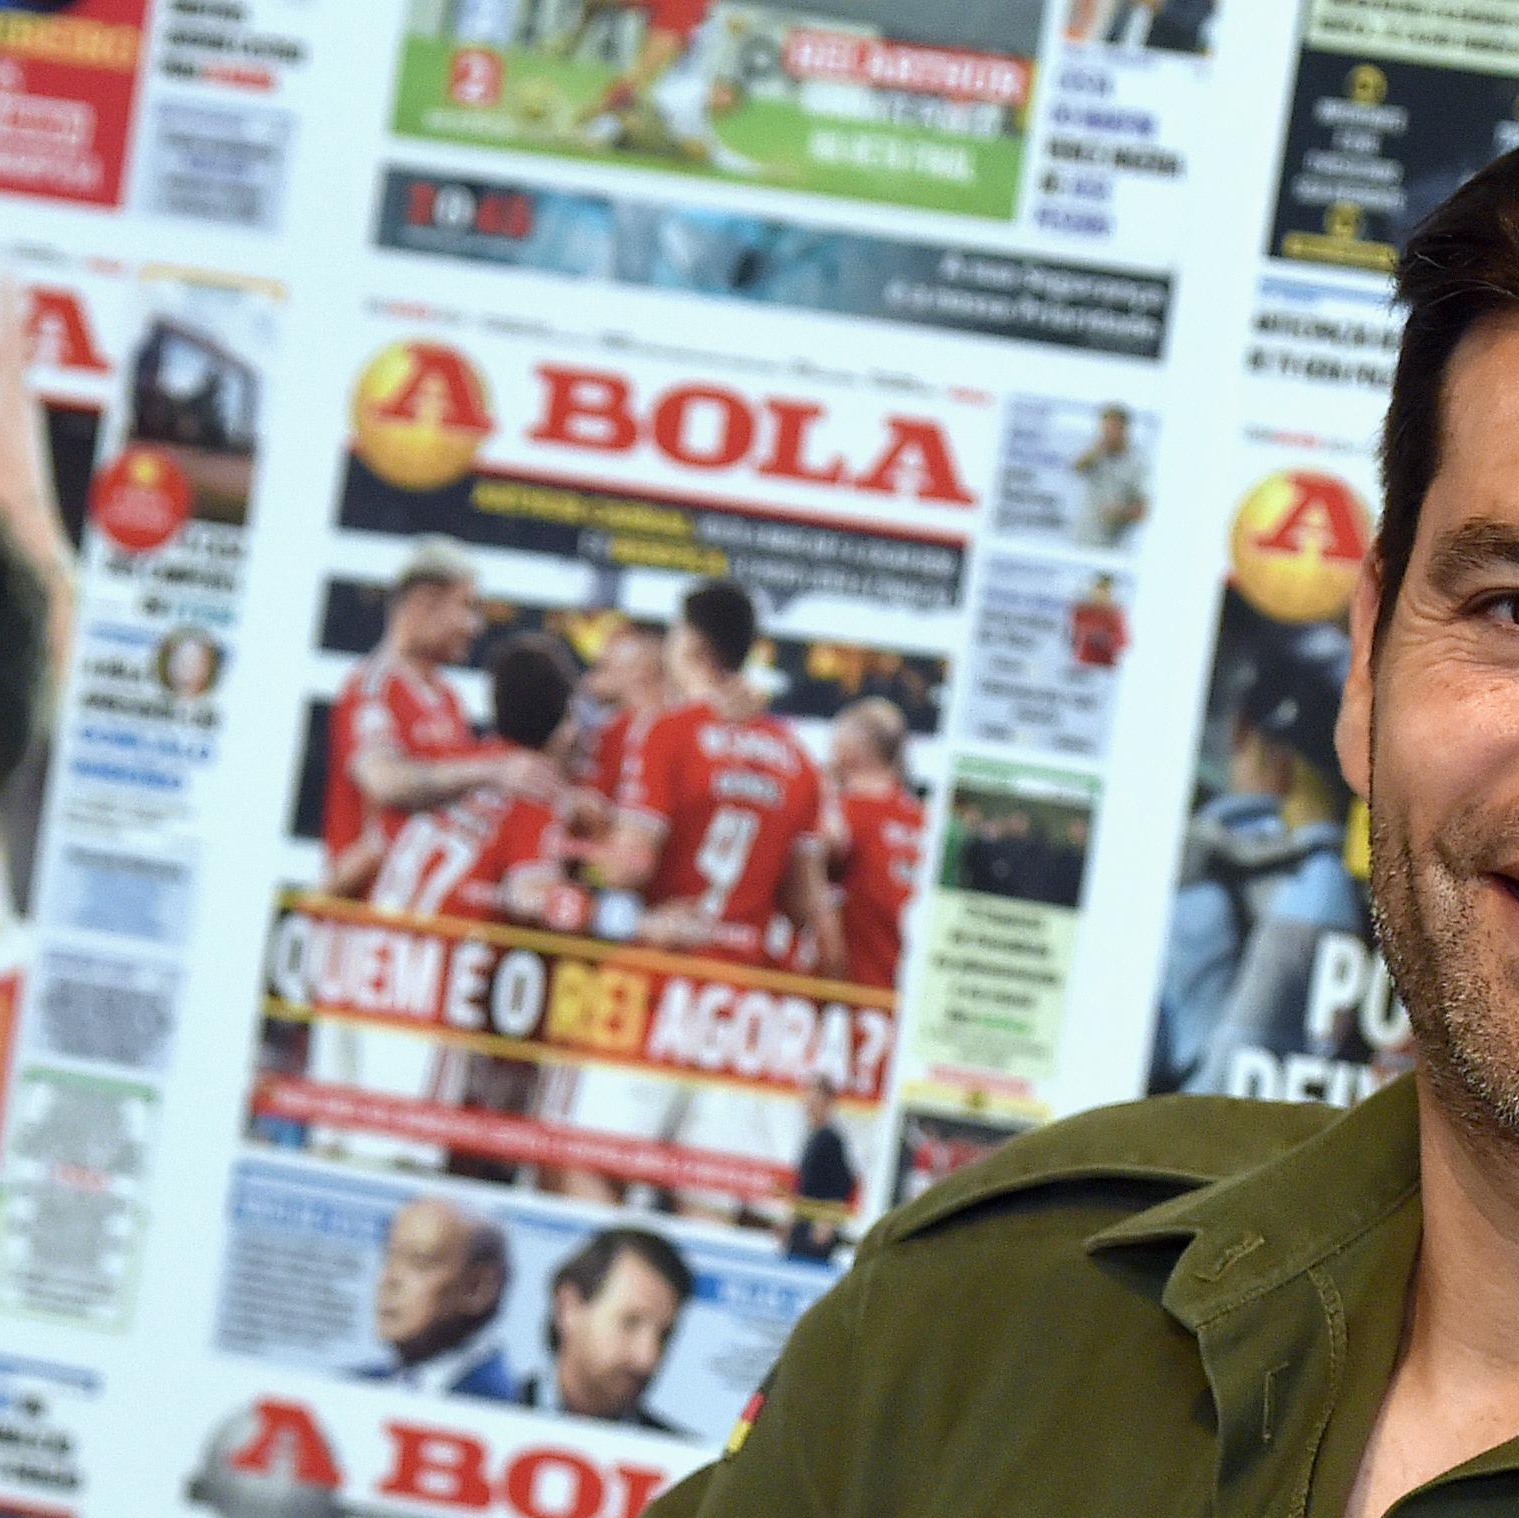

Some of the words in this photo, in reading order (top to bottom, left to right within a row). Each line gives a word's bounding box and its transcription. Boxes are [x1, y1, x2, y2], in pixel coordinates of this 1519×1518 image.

[374, 342, 494, 434] A
[528, 361, 976, 508] BOLA
[1255, 470, 1370, 561] A
[269, 908, 440, 1018] QUEM
[448, 934, 489, 1031] É
[491, 947, 549, 1040] O
[647, 975, 889, 1096] AGORA?
[226, 1398, 345, 1491] A
